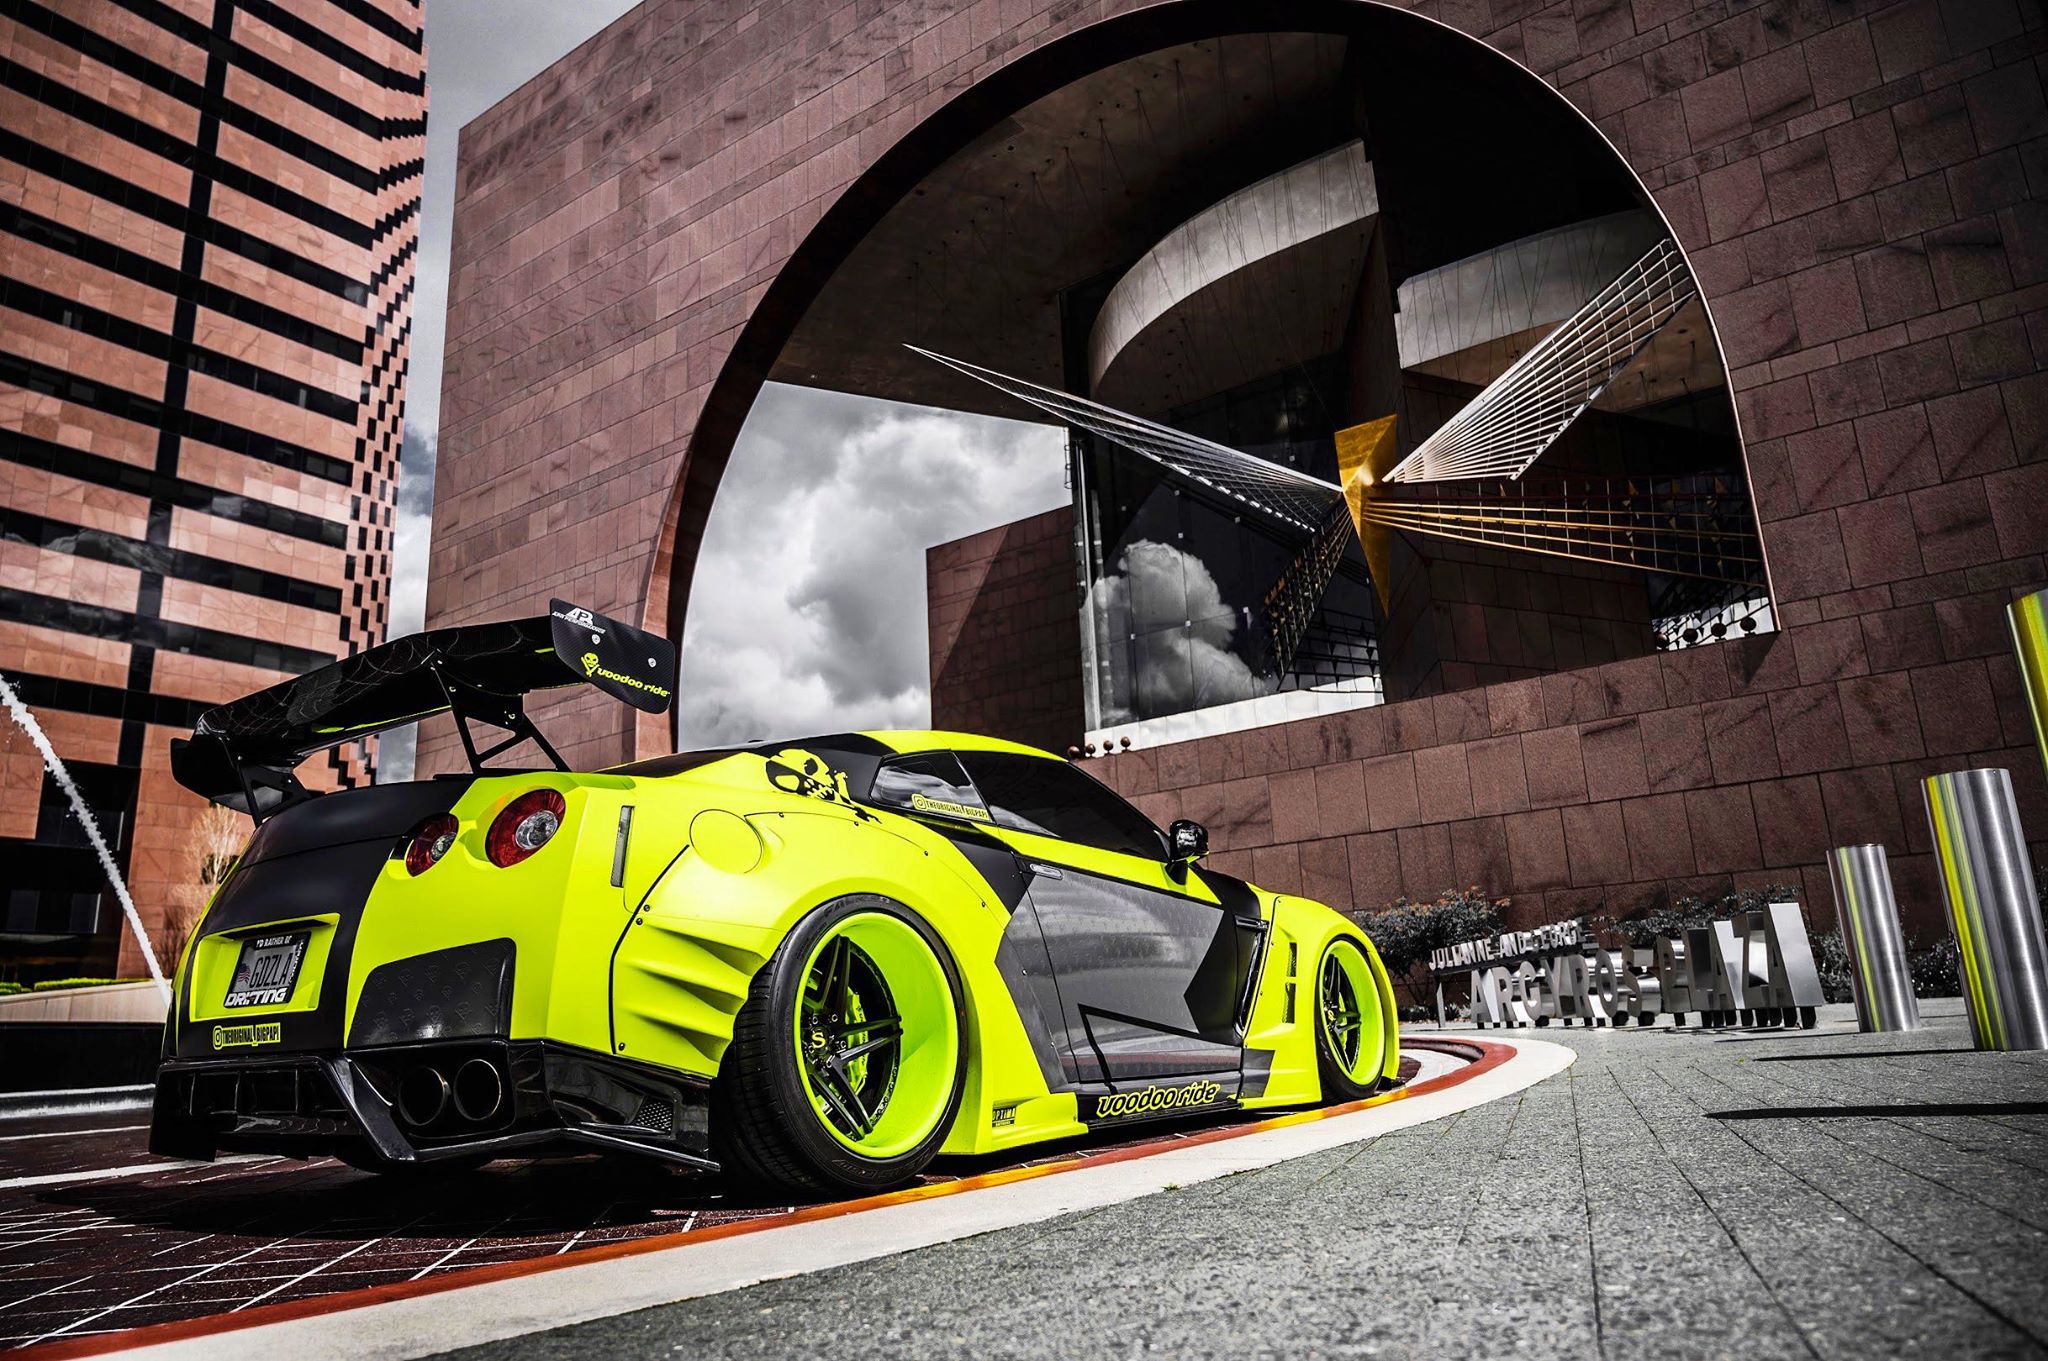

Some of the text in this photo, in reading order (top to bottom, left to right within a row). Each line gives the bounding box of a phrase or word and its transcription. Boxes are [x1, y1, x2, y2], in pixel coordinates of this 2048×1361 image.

[597, 667, 668, 697] voodoo ride
[264, 936, 284, 947] RATHER
[1428, 918, 1590, 971] JULIANNE AND GEORGE
[249, 952, 294, 988] GDZLA
[1470, 903, 1824, 1023] ARGYROS PLAZA
[811, 1032, 827, 1049] S
[1096, 1080, 1218, 1117] voodoo ride
